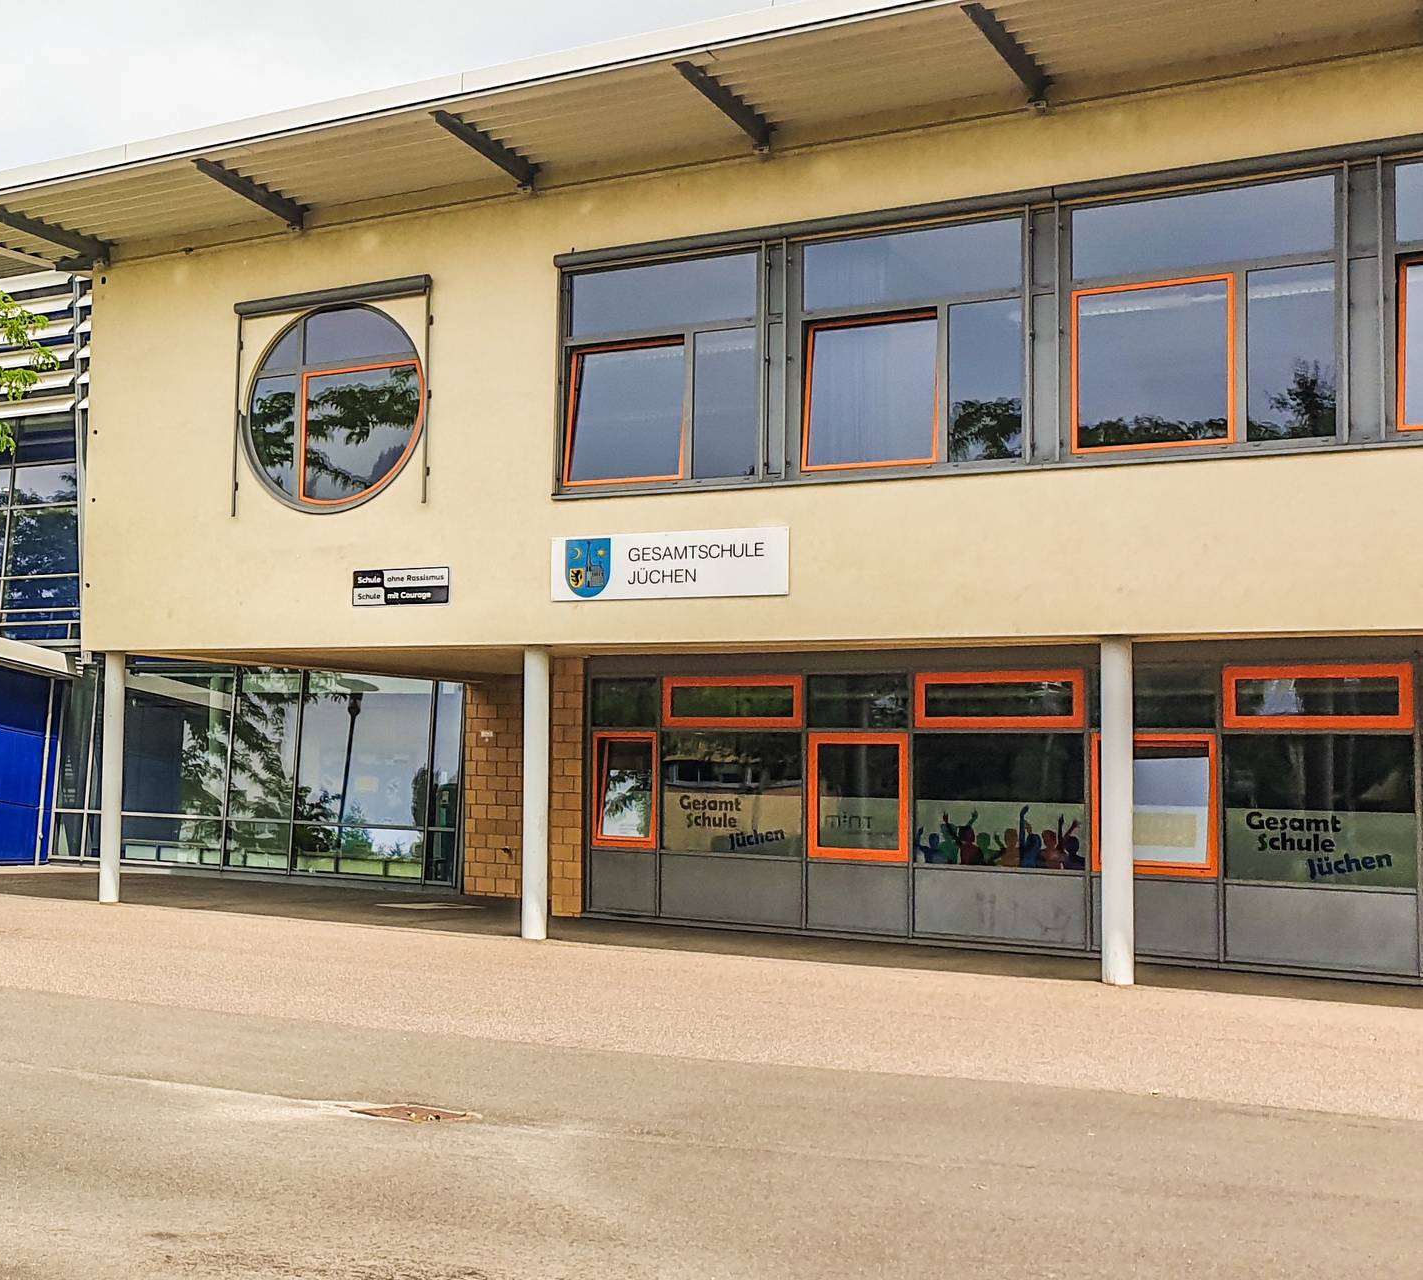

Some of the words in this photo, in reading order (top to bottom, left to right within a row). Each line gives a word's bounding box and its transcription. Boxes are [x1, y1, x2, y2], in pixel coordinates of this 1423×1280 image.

[627, 542, 765, 562] GESAMTSCHULE
[357, 575, 382, 584] Schule
[406, 573, 445, 582] Rassismus
[627, 567, 697, 585] JÜCHEN
[357, 592, 381, 600] Schule
[387, 591, 399, 599] mit
[400, 591, 432, 600] Courage
[679, 794, 742, 812] Gesamt
[686, 812, 738, 828] Schule
[1245, 811, 1342, 833] Gesamt
[728, 829, 785, 851] Jüchen
[1257, 832, 1336, 853] Schule
[1307, 853, 1393, 880] Jüchen
